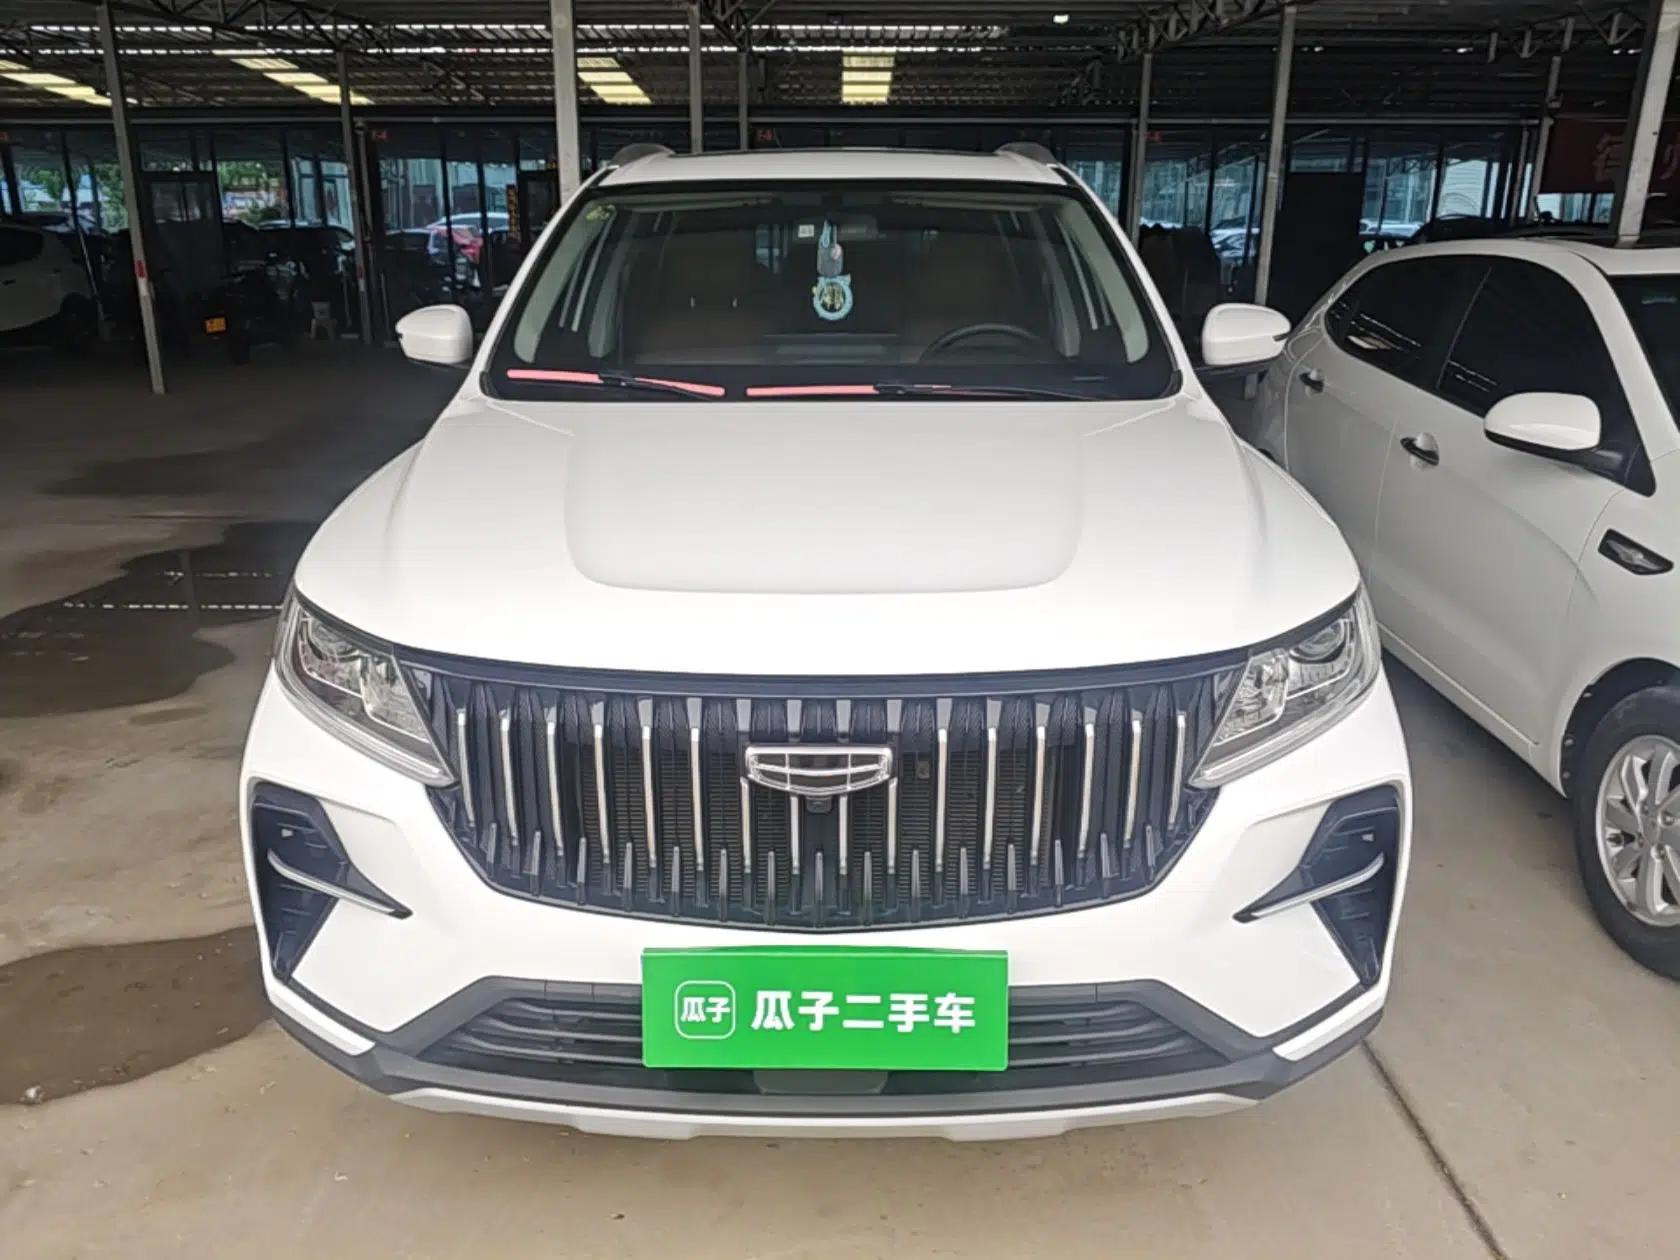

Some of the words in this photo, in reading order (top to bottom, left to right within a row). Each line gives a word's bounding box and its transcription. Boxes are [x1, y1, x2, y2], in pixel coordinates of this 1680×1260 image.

[680, 997, 731, 1024] 瓜子
[751, 990, 976, 1034] 瓜子二手车
